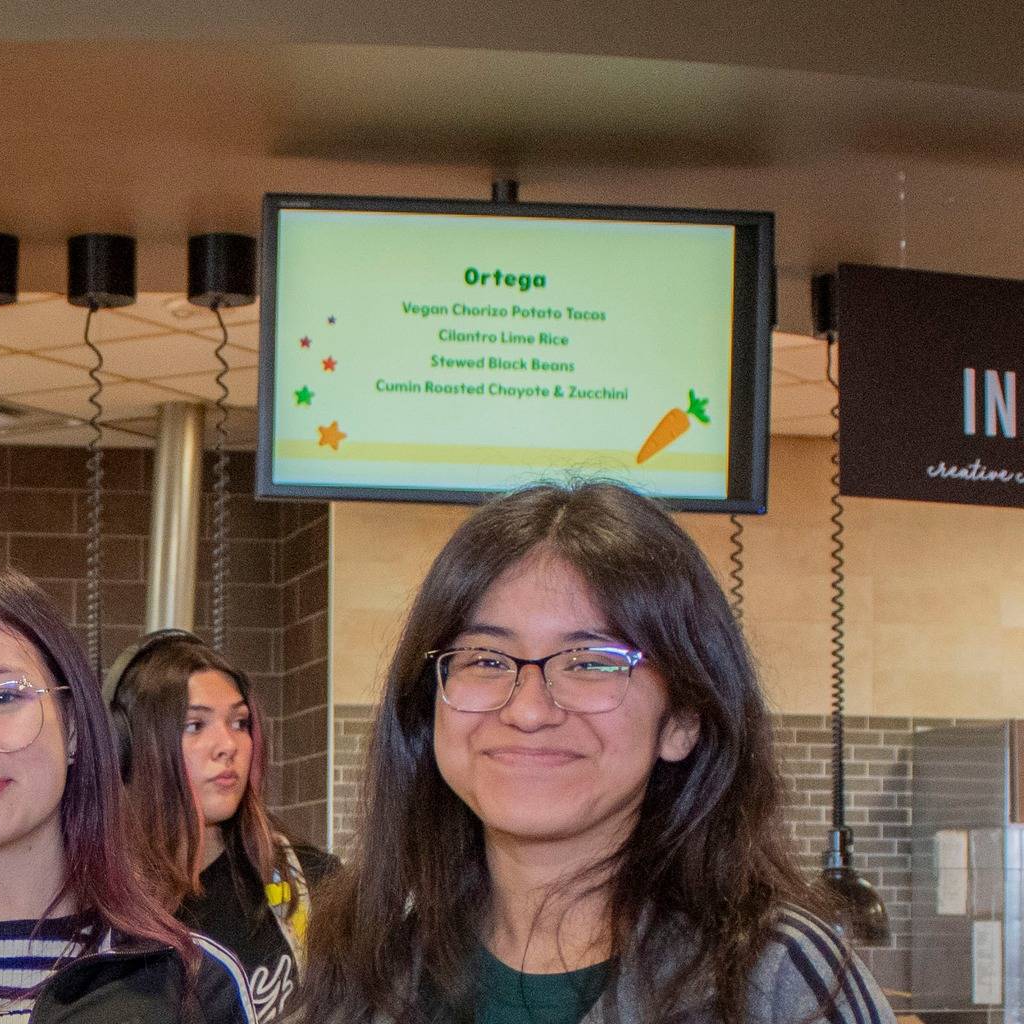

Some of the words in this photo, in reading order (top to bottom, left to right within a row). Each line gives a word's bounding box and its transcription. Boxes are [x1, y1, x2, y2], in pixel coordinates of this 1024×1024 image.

[465, 267, 546, 291] Ortega
[402, 302, 448, 317] Vegan
[452, 303, 508, 317] Chorizo
[512, 305, 562, 319] Potato
[567, 307, 606, 320] Tacos
[439, 328, 497, 343] Cilantro
[501, 331, 535, 344] Lime
[539, 332, 569, 345] Rice
[431, 354, 485, 368] Stewed
[488, 357, 527, 370] Black
[531, 358, 575, 372] Beans
[376, 379, 421, 393] Cumin
[425, 381, 484, 395] Roasted
[488, 383, 549, 399] Chayote
[554, 385, 564, 398] &
[569, 385, 628, 401] Zucchini
[927, 459, 1014, 482] creative
